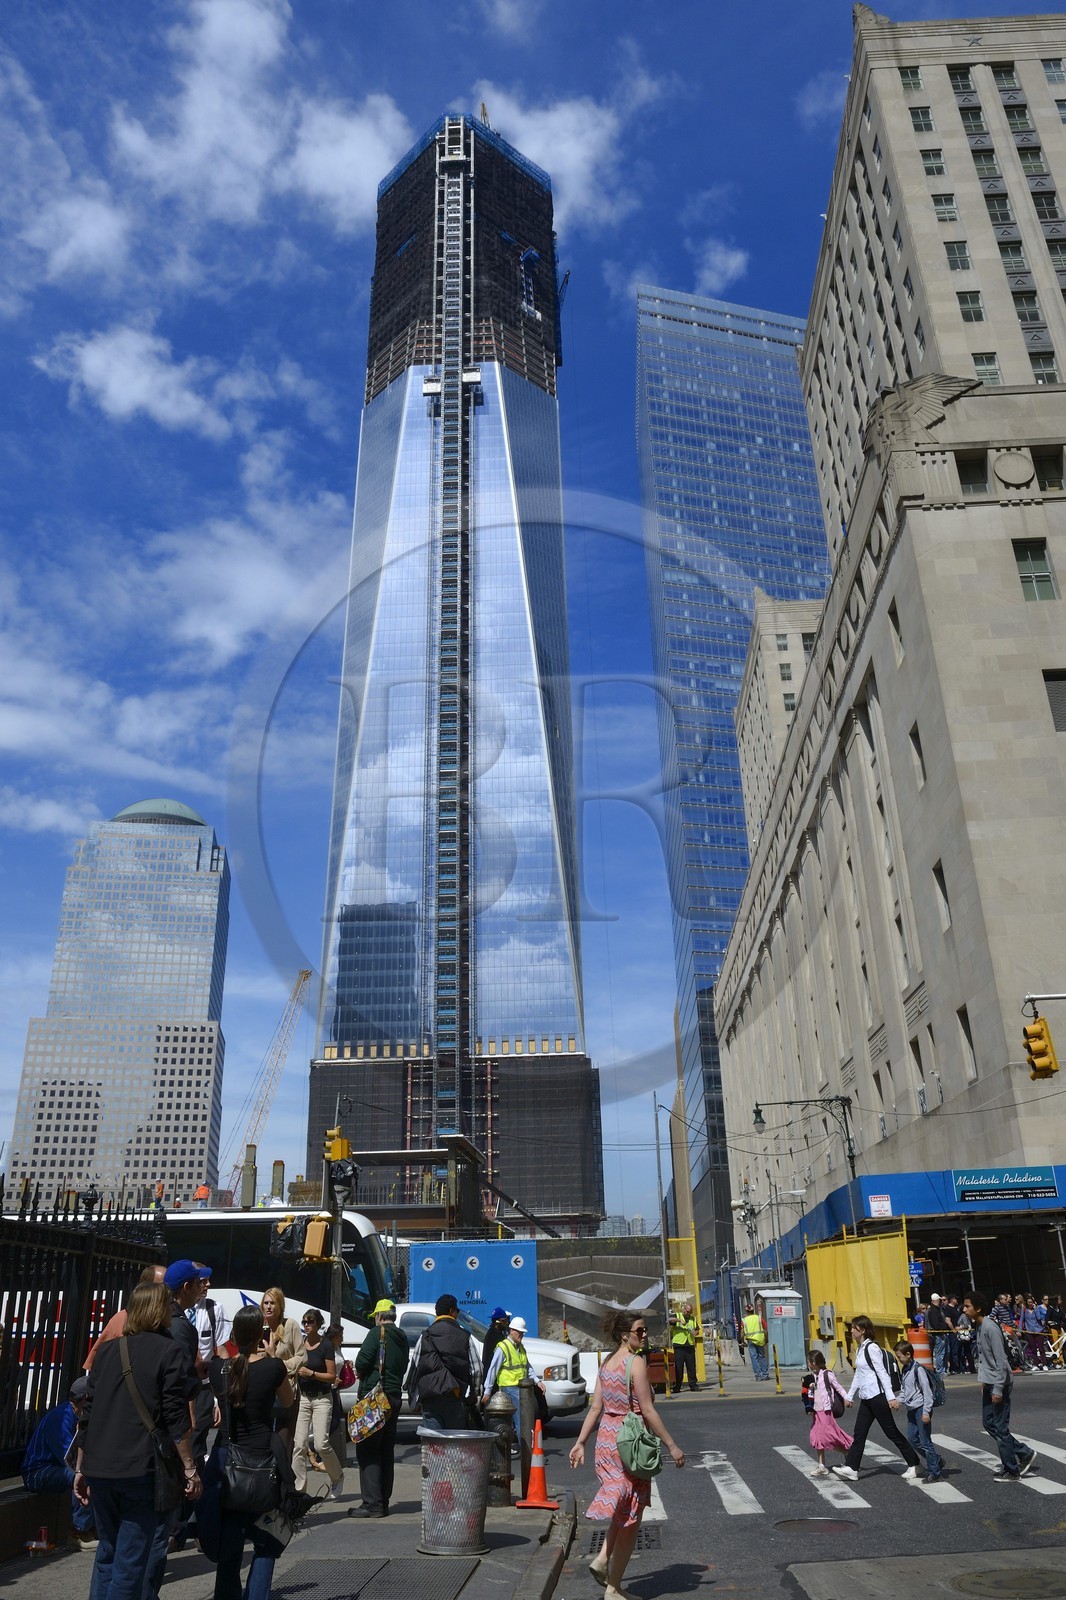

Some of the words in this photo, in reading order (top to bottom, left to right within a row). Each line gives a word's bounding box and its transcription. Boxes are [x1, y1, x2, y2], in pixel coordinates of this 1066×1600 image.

[956, 1175, 1000, 1186] Malatesta
[1003, 1173, 1042, 1184] Paladino
[465, 1290, 481, 1300] 9/11
